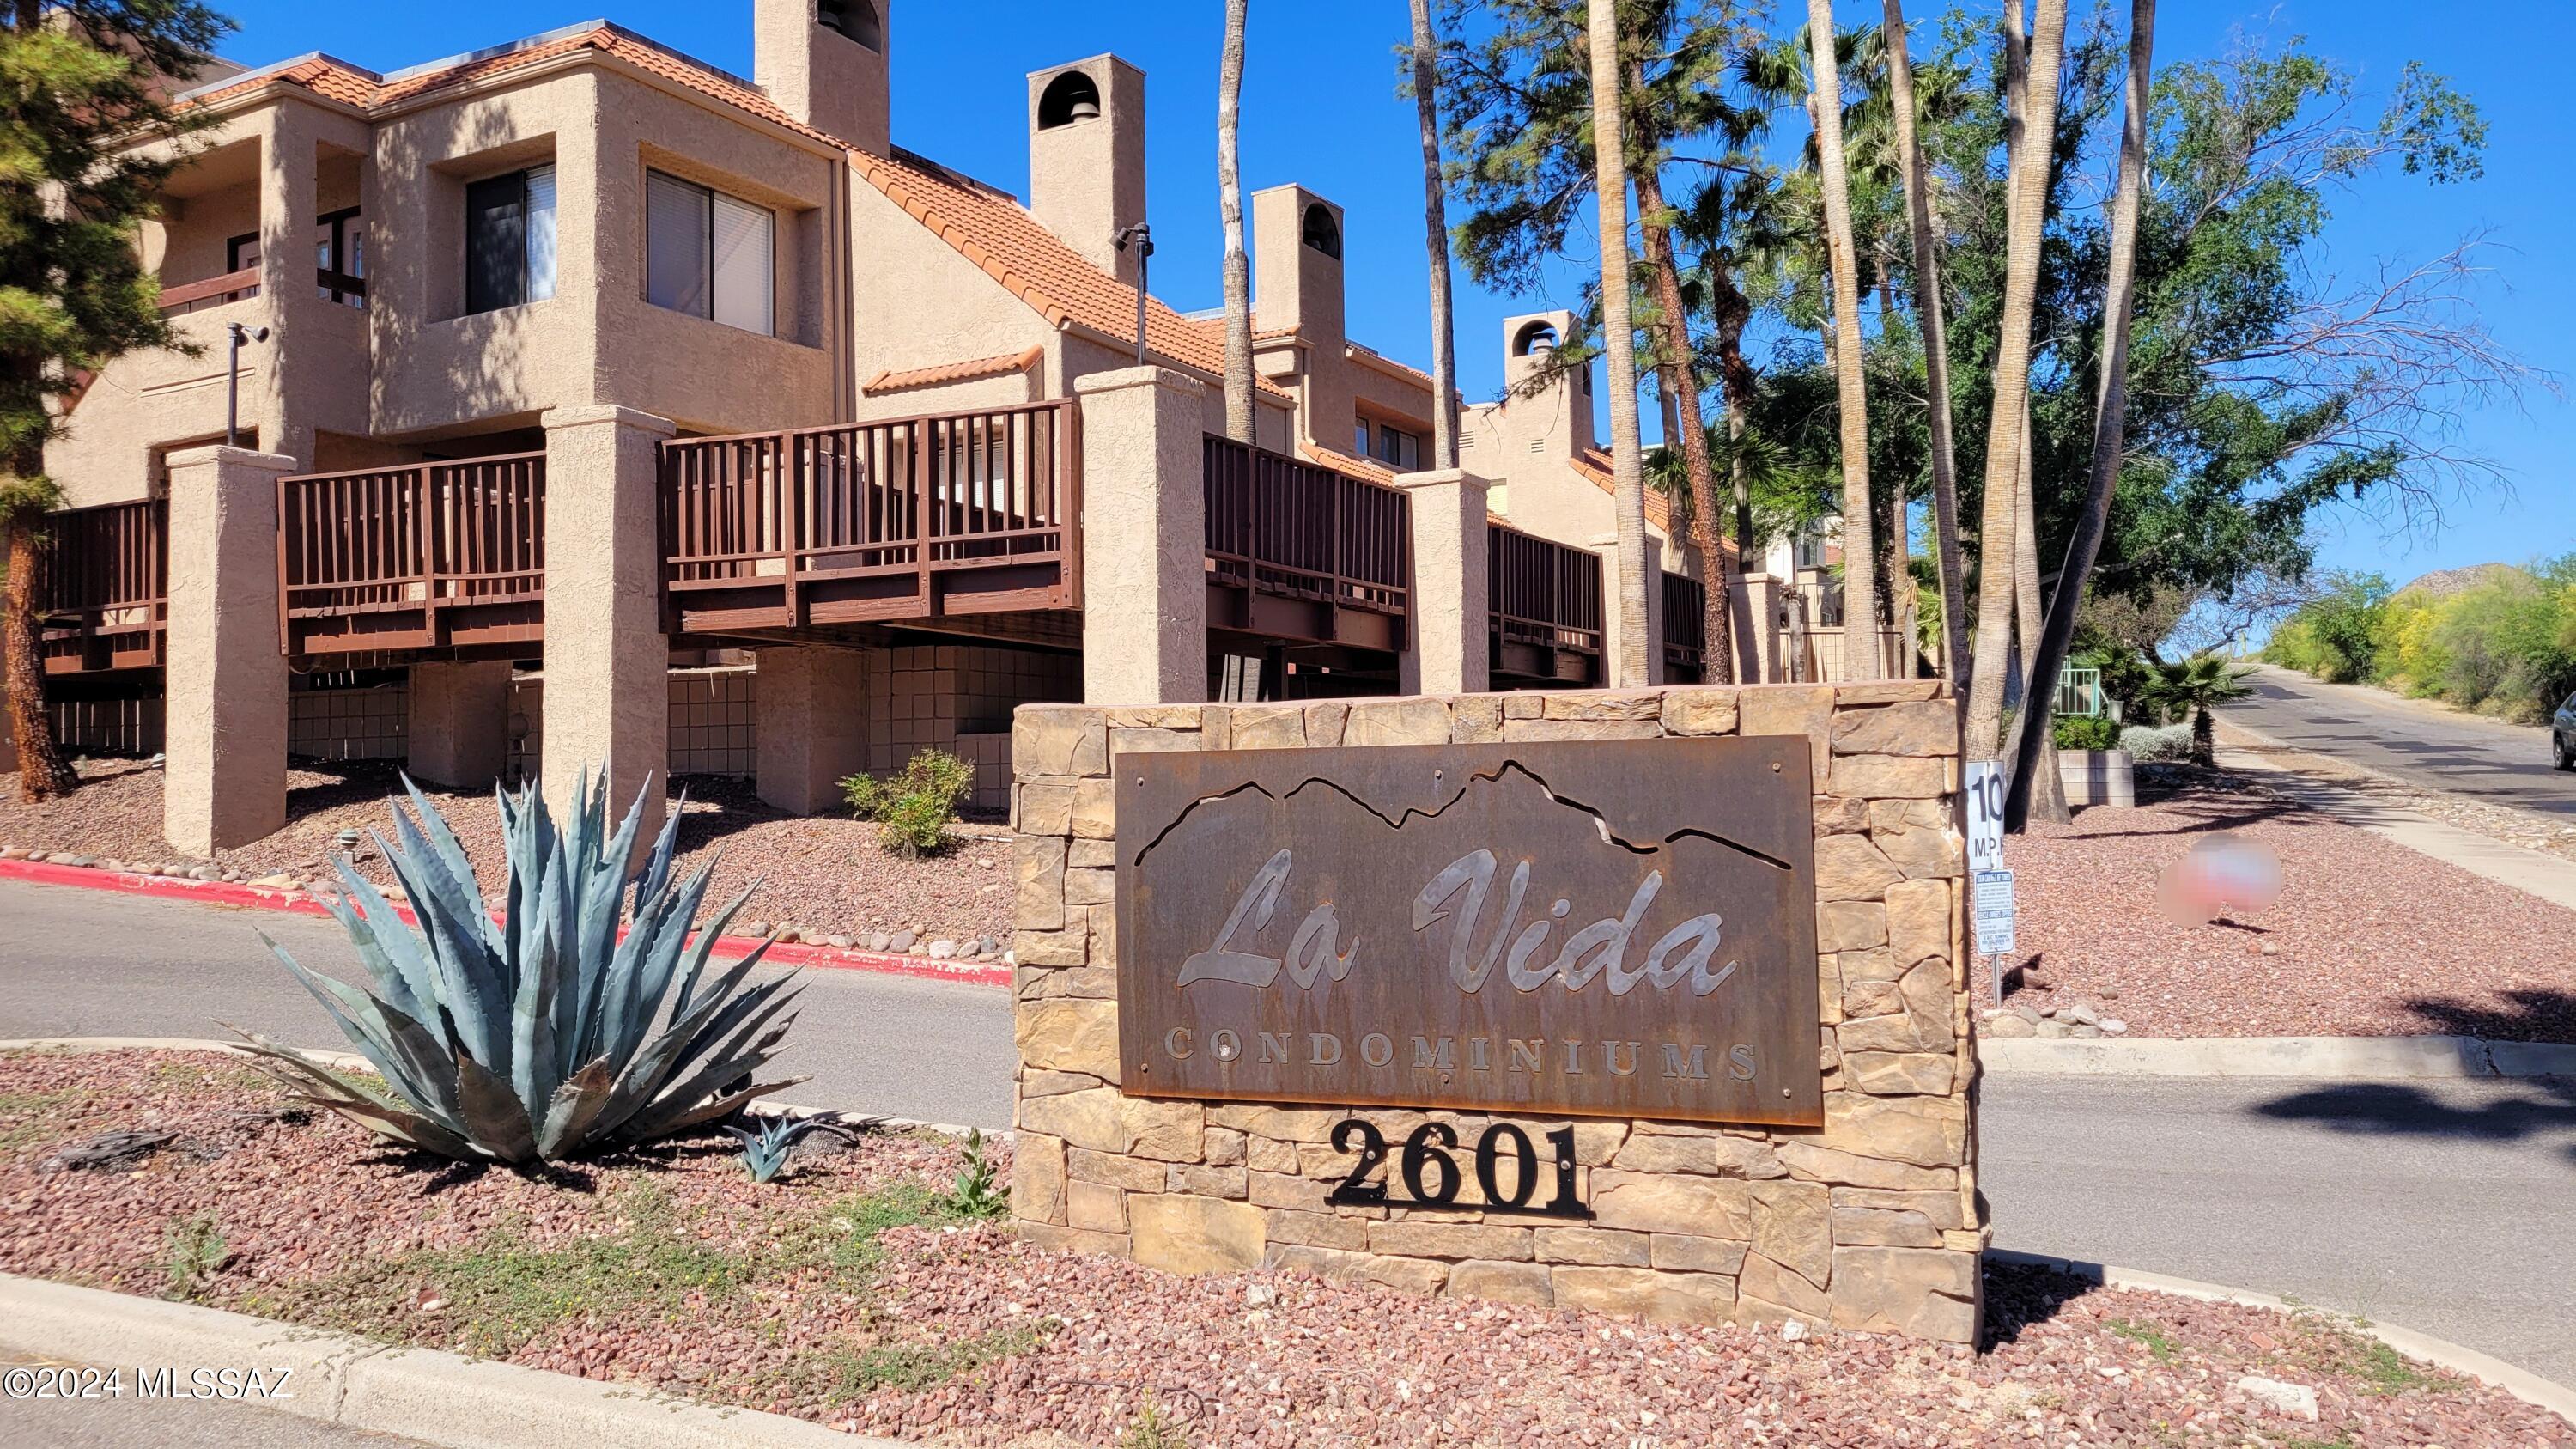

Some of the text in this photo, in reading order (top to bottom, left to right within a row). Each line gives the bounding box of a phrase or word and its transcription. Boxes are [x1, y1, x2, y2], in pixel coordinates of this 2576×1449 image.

[1971, 773, 2003, 822] 10
[1177, 849, 1739, 997] La Vida
[1164, 1026, 1758, 1081] CONDOMINIUMS
[1329, 1119, 1591, 1215] 2601
